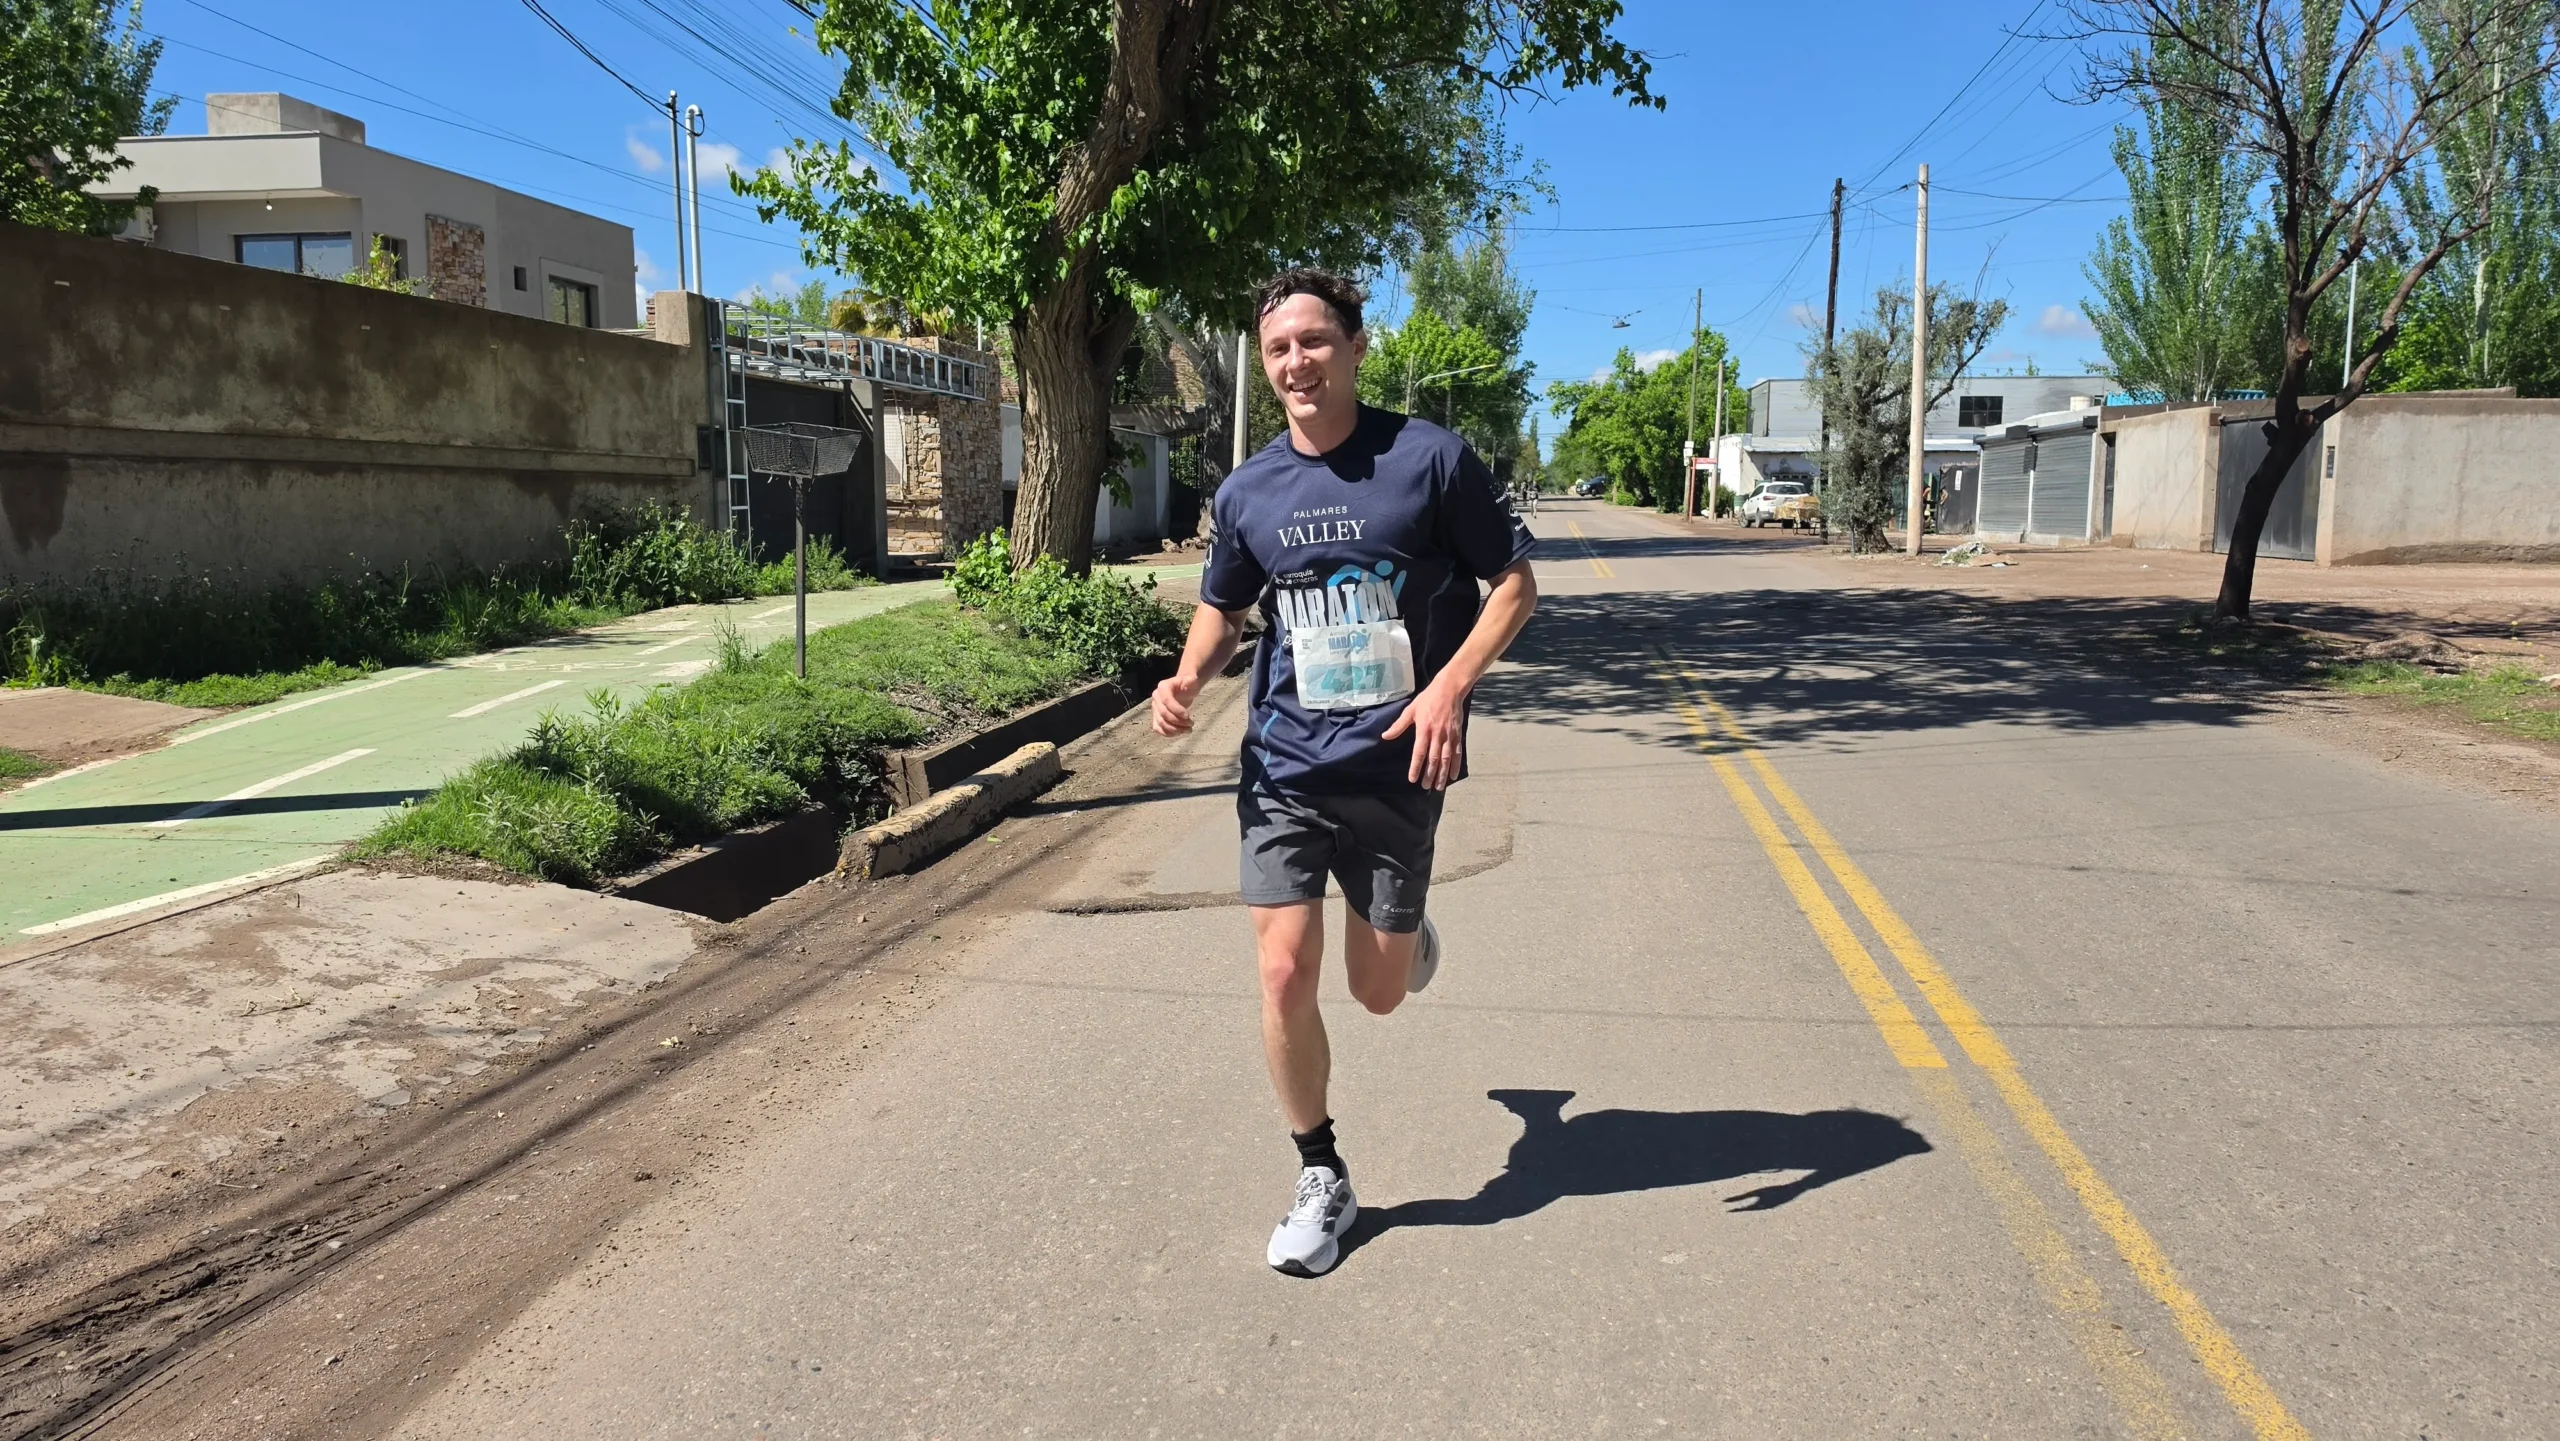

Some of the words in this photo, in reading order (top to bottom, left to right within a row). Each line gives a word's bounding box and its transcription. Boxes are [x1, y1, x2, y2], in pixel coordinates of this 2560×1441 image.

[1293, 505, 1348, 519] PALMARES
[1277, 519, 1366, 548] VALLEY
[1321, 663, 1386, 693] 427
